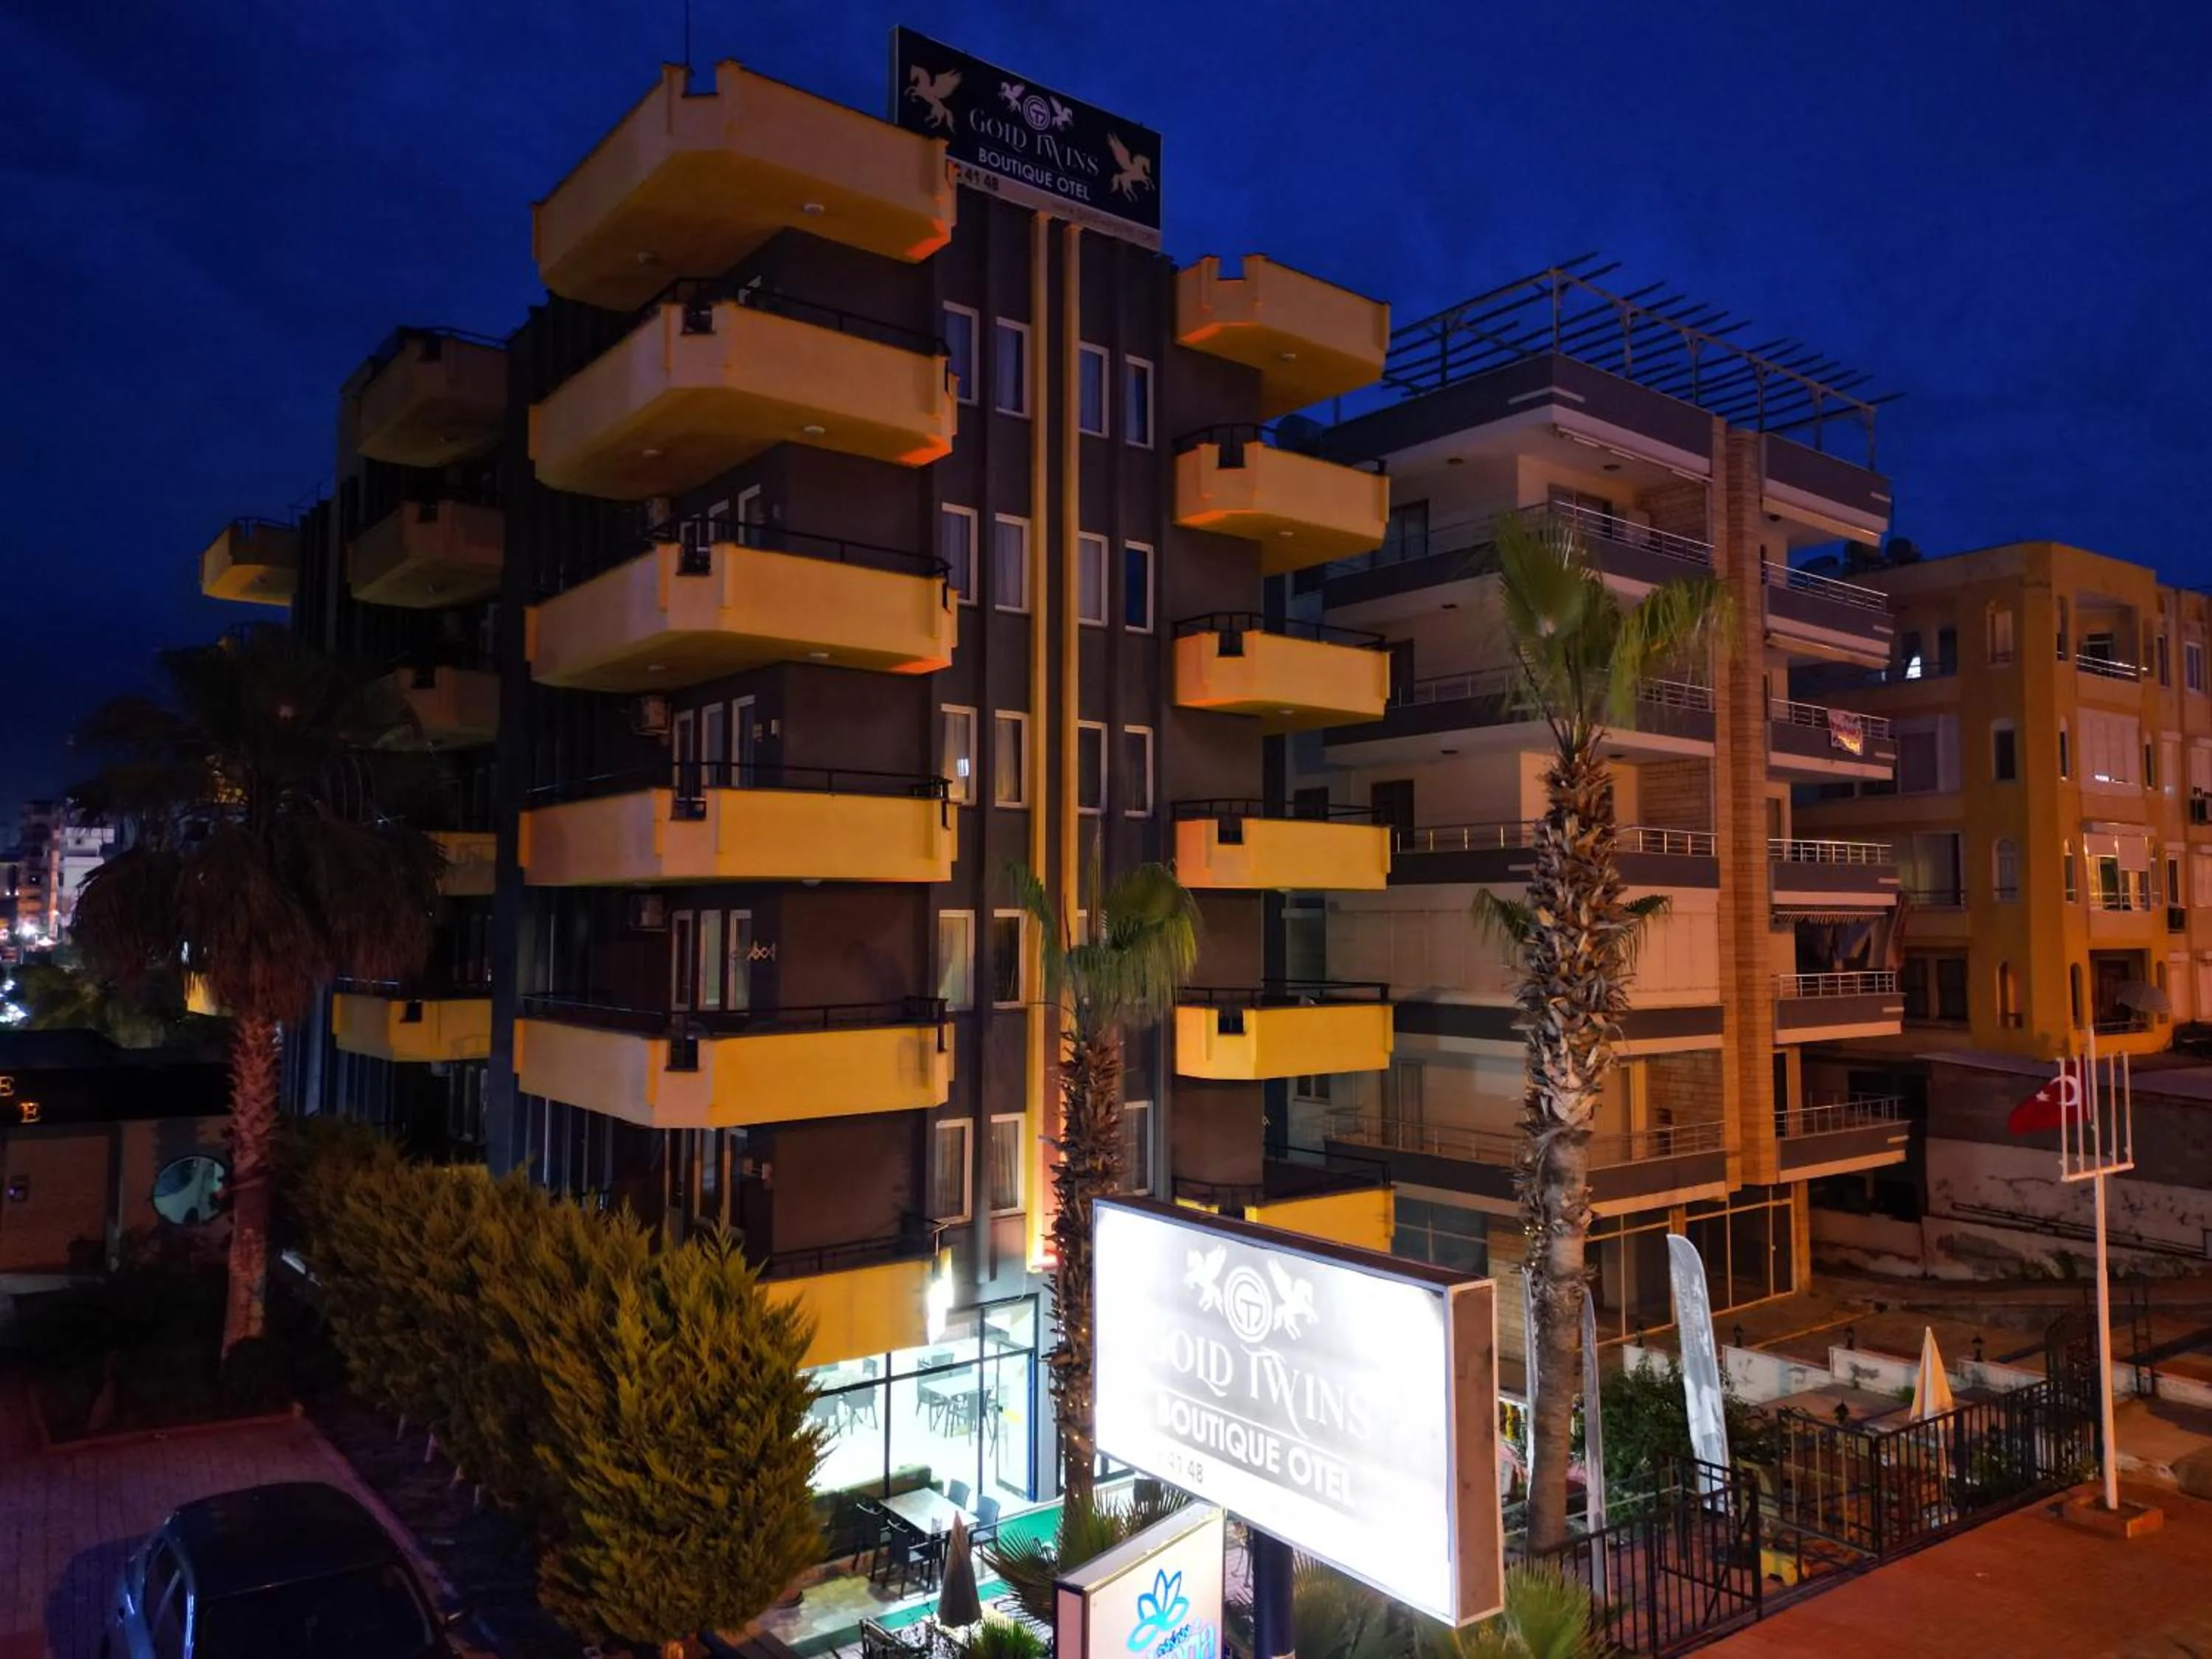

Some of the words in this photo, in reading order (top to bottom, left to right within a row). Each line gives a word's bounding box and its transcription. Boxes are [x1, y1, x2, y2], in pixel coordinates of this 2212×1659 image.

[969, 108, 1027, 153] GOLD
[1037, 132, 1100, 177] TWINS
[978, 147, 1053, 188] BOUTIQUE
[1057, 173, 1091, 201] OTEL
[1161, 1329, 1233, 1397] OLD
[1239, 1343, 1371, 1440] TWINS
[1187, 1460, 1203, 1484] 48
[1287, 1446, 1357, 1509] OTEL
